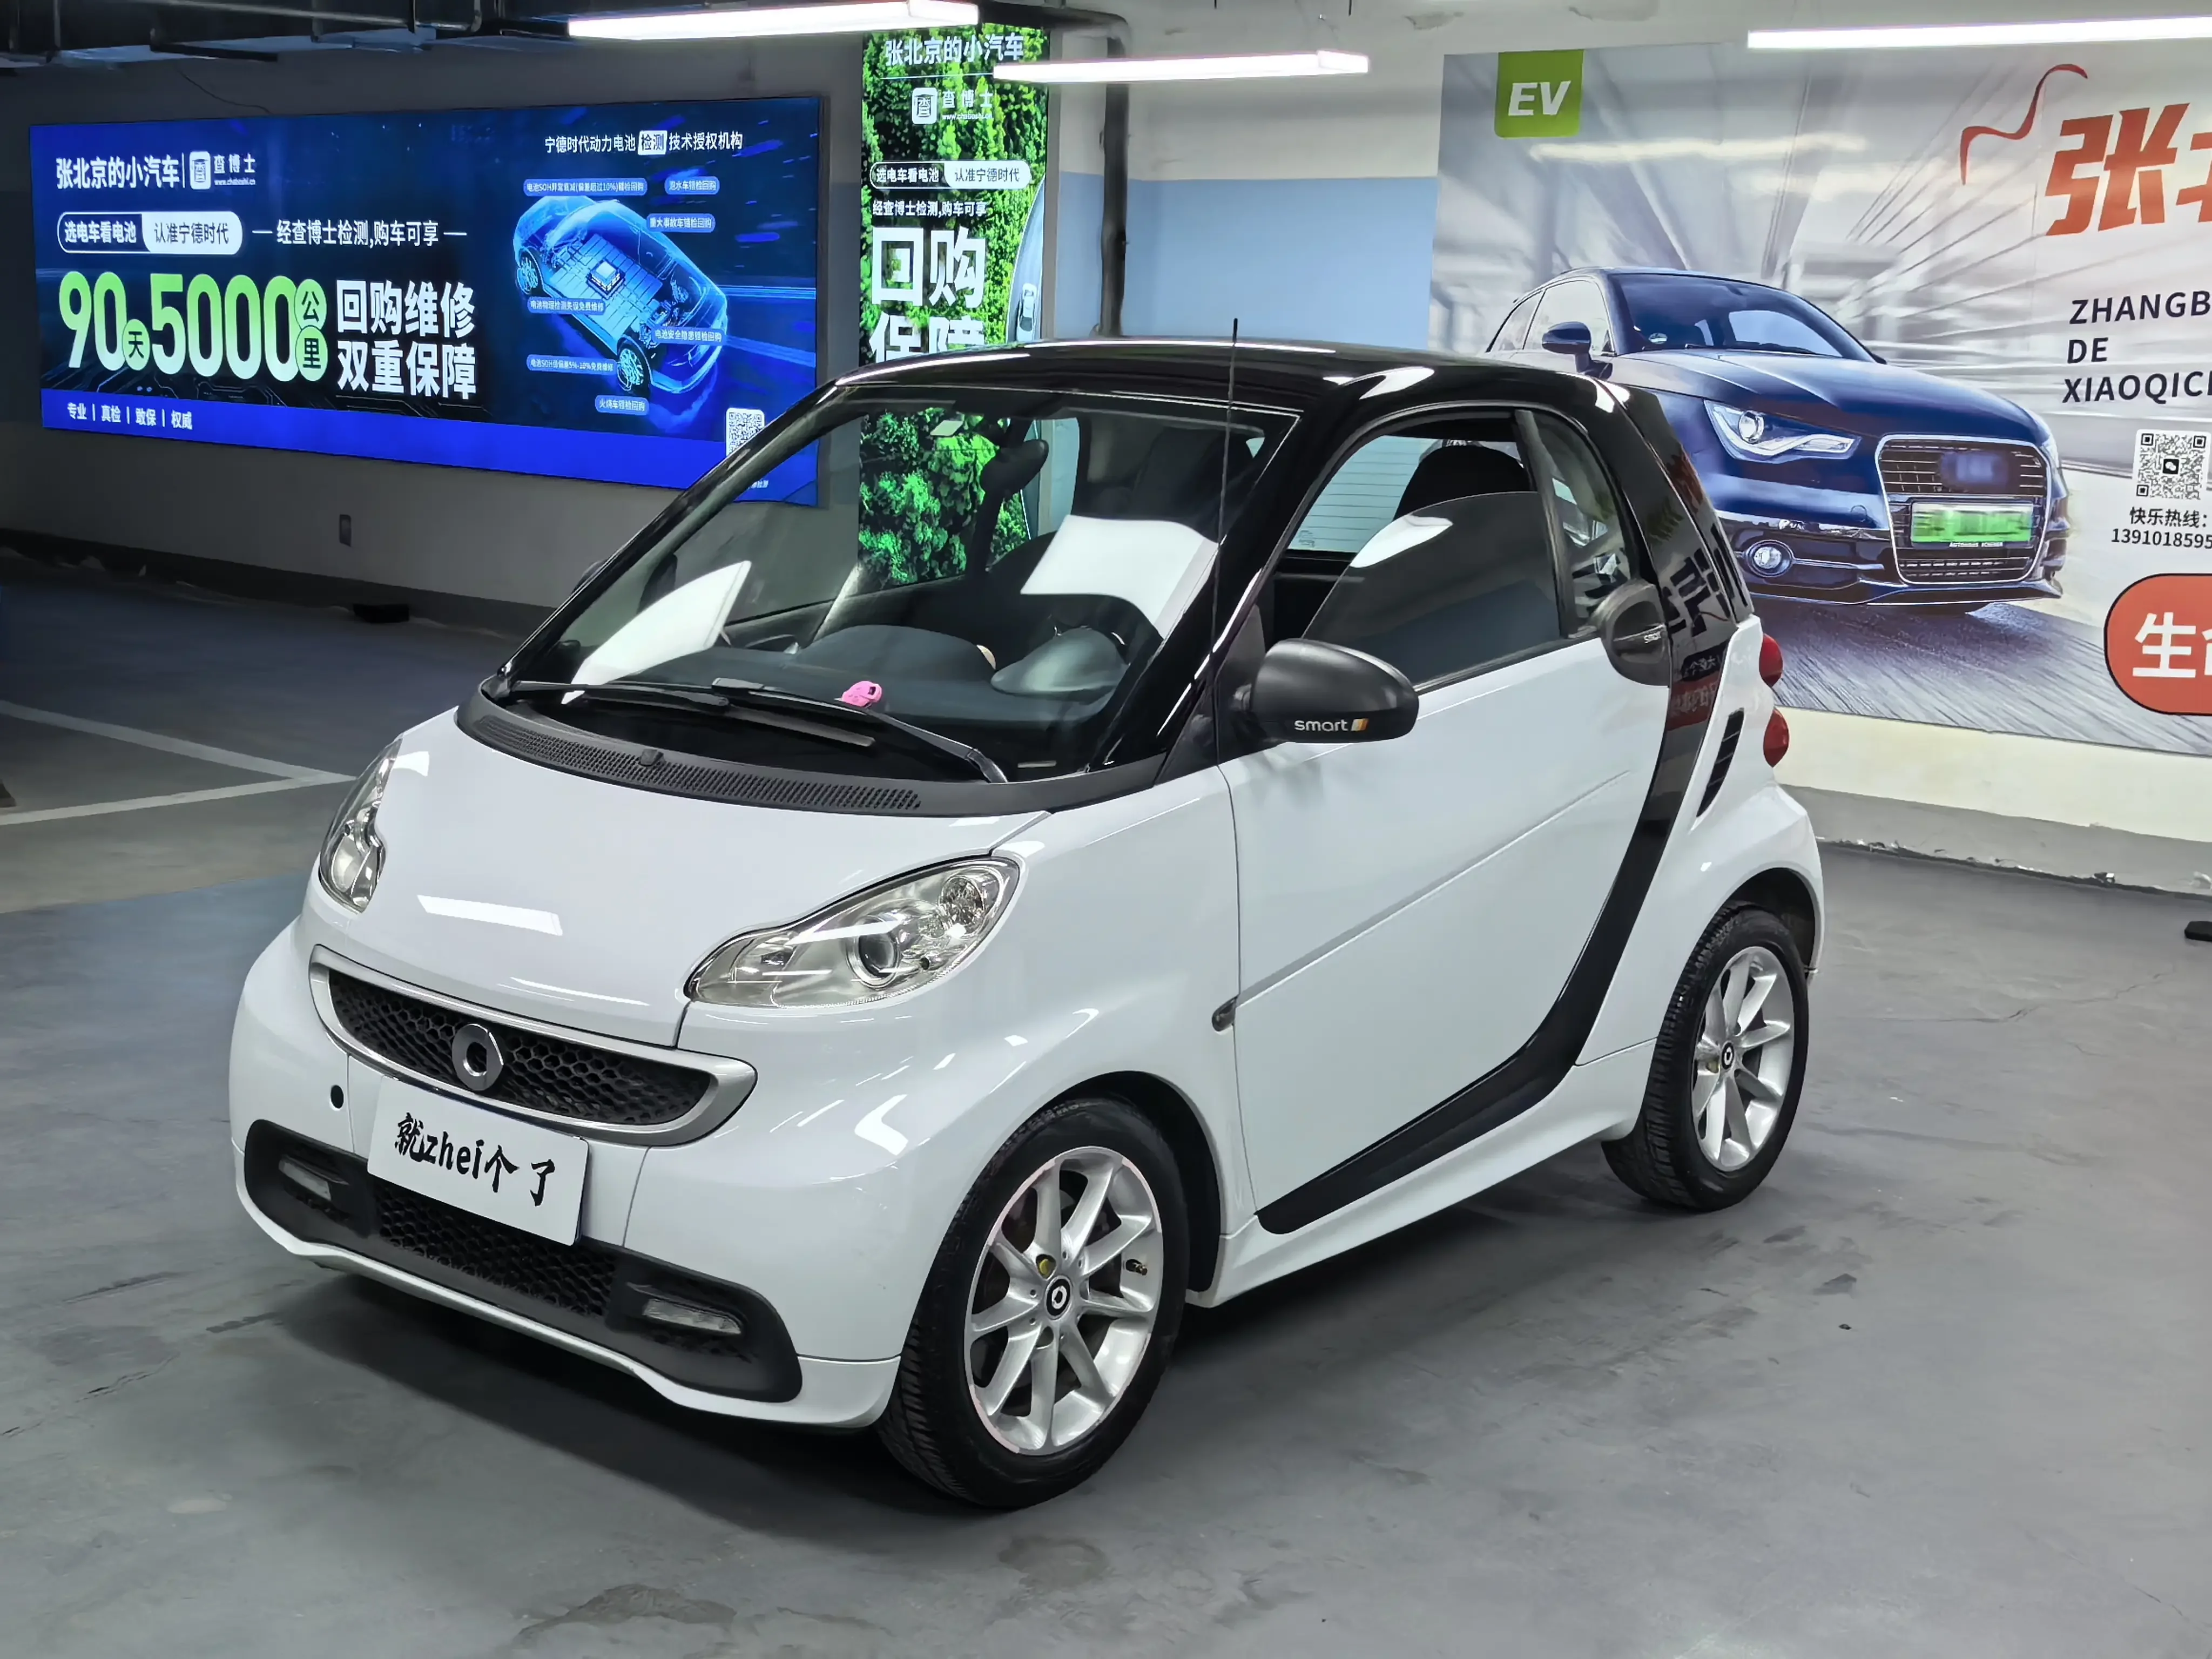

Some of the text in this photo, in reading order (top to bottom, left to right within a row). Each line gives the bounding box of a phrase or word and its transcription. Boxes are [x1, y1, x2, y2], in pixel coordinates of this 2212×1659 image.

[885, 32, 1024, 66] 张北京的小汽车
[942, 89, 993, 108] 查博士
[1508, 80, 1570, 116] EV
[56, 154, 180, 188] 张北京的小汽车
[214, 153, 255, 173] 查博士
[876, 167, 1020, 183] 选电车看电池 认准宁德时代
[64, 220, 229, 244] 选电车看电池 认准宁德时代
[872, 226, 987, 308] 回购
[336, 279, 475, 339] 回购维修
[2069, 290, 2211, 325] ZHANGB
[2067, 337, 2108, 364] DE
[337, 339, 476, 400] 双重保障
[68, 402, 193, 430] 专业 真检 敢保 权威
[2129, 507, 2207, 528] 快乐热线：
[2111, 528, 2212, 549] 1391018595
[2132, 611, 2212, 678] 生
[1294, 719, 1348, 731] smart
